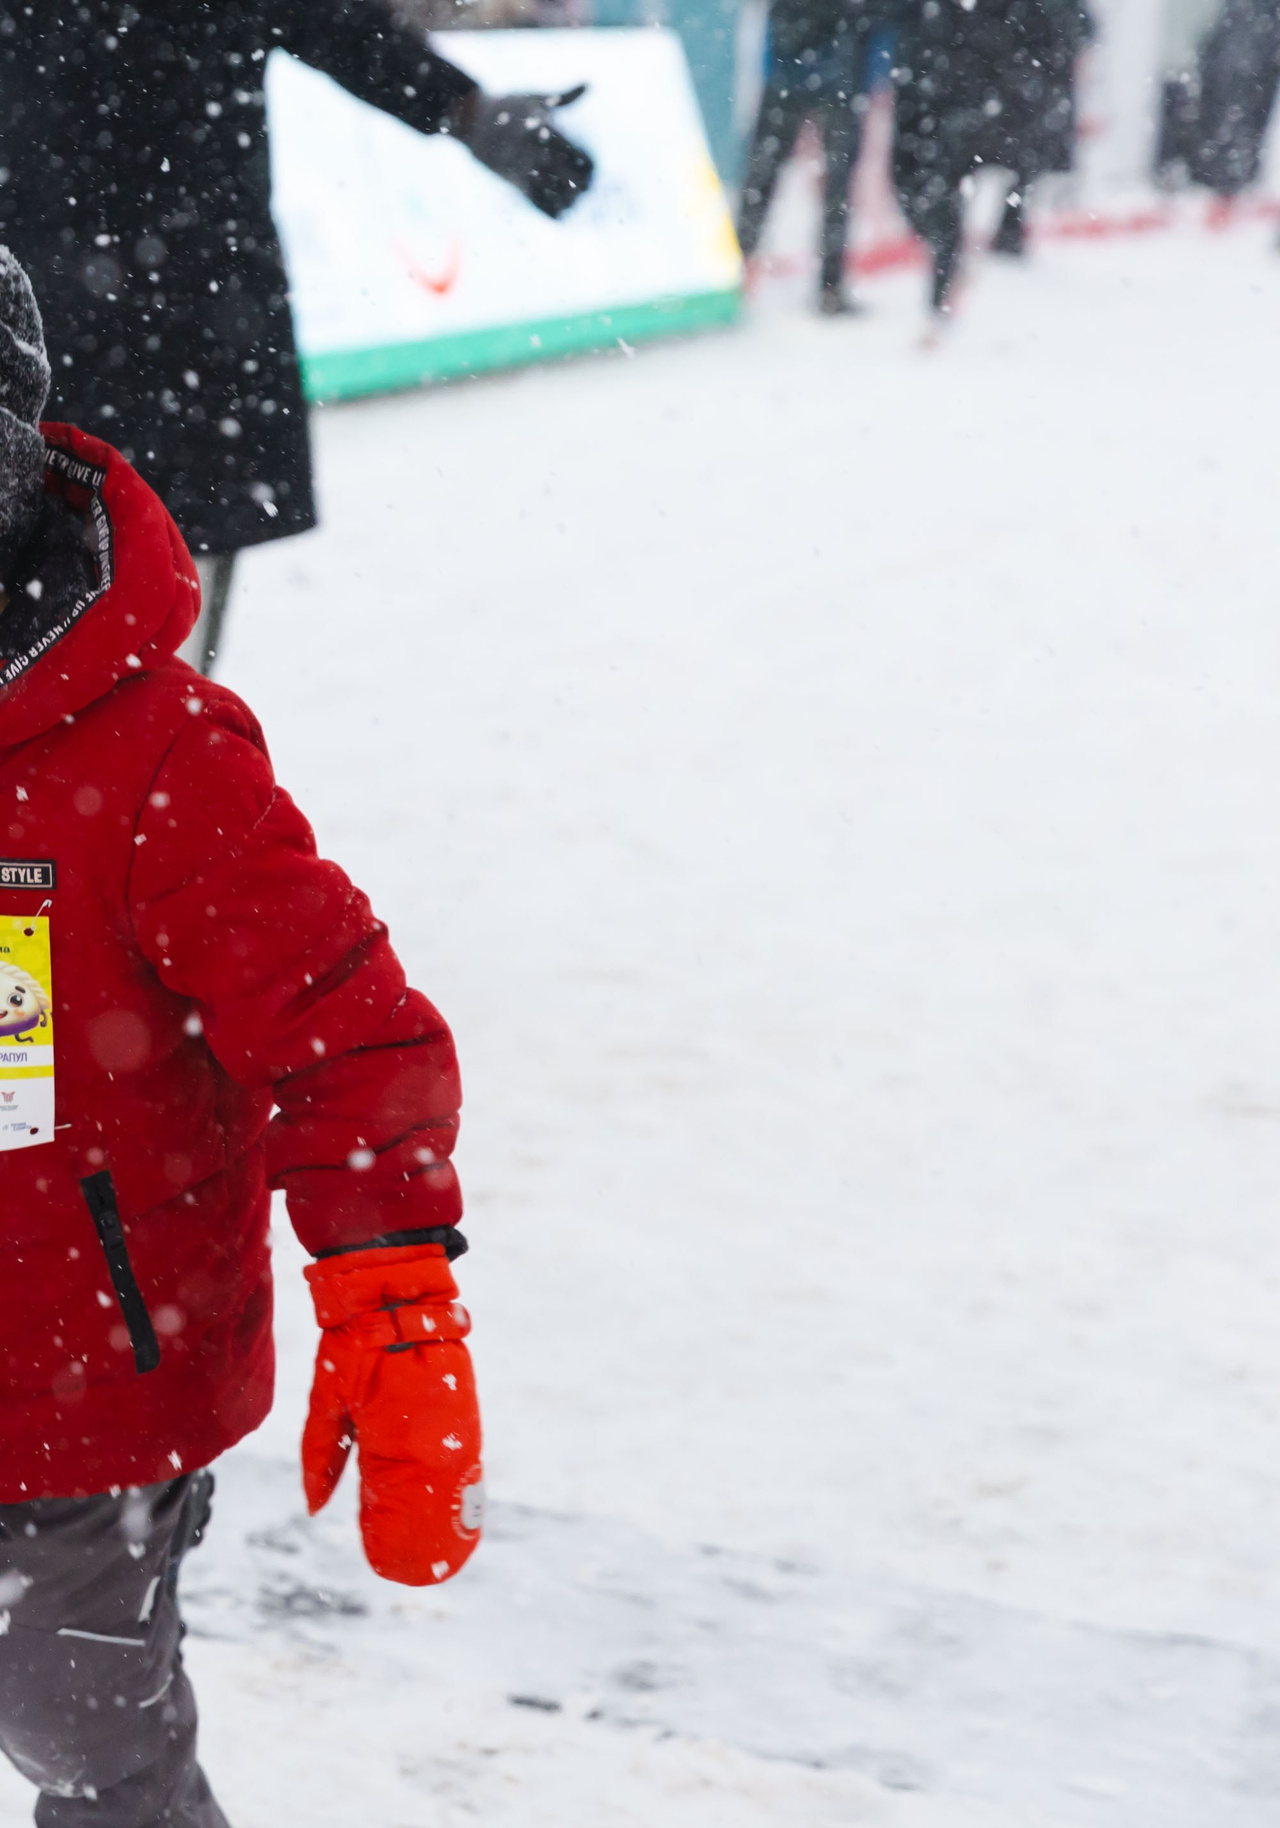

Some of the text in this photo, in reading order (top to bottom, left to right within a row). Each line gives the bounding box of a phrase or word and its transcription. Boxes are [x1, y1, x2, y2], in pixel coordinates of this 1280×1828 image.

[28, 624, 64, 658] NEVER
[5, 654, 30, 681] GIVE
[1, 866, 43, 884] STYLE
